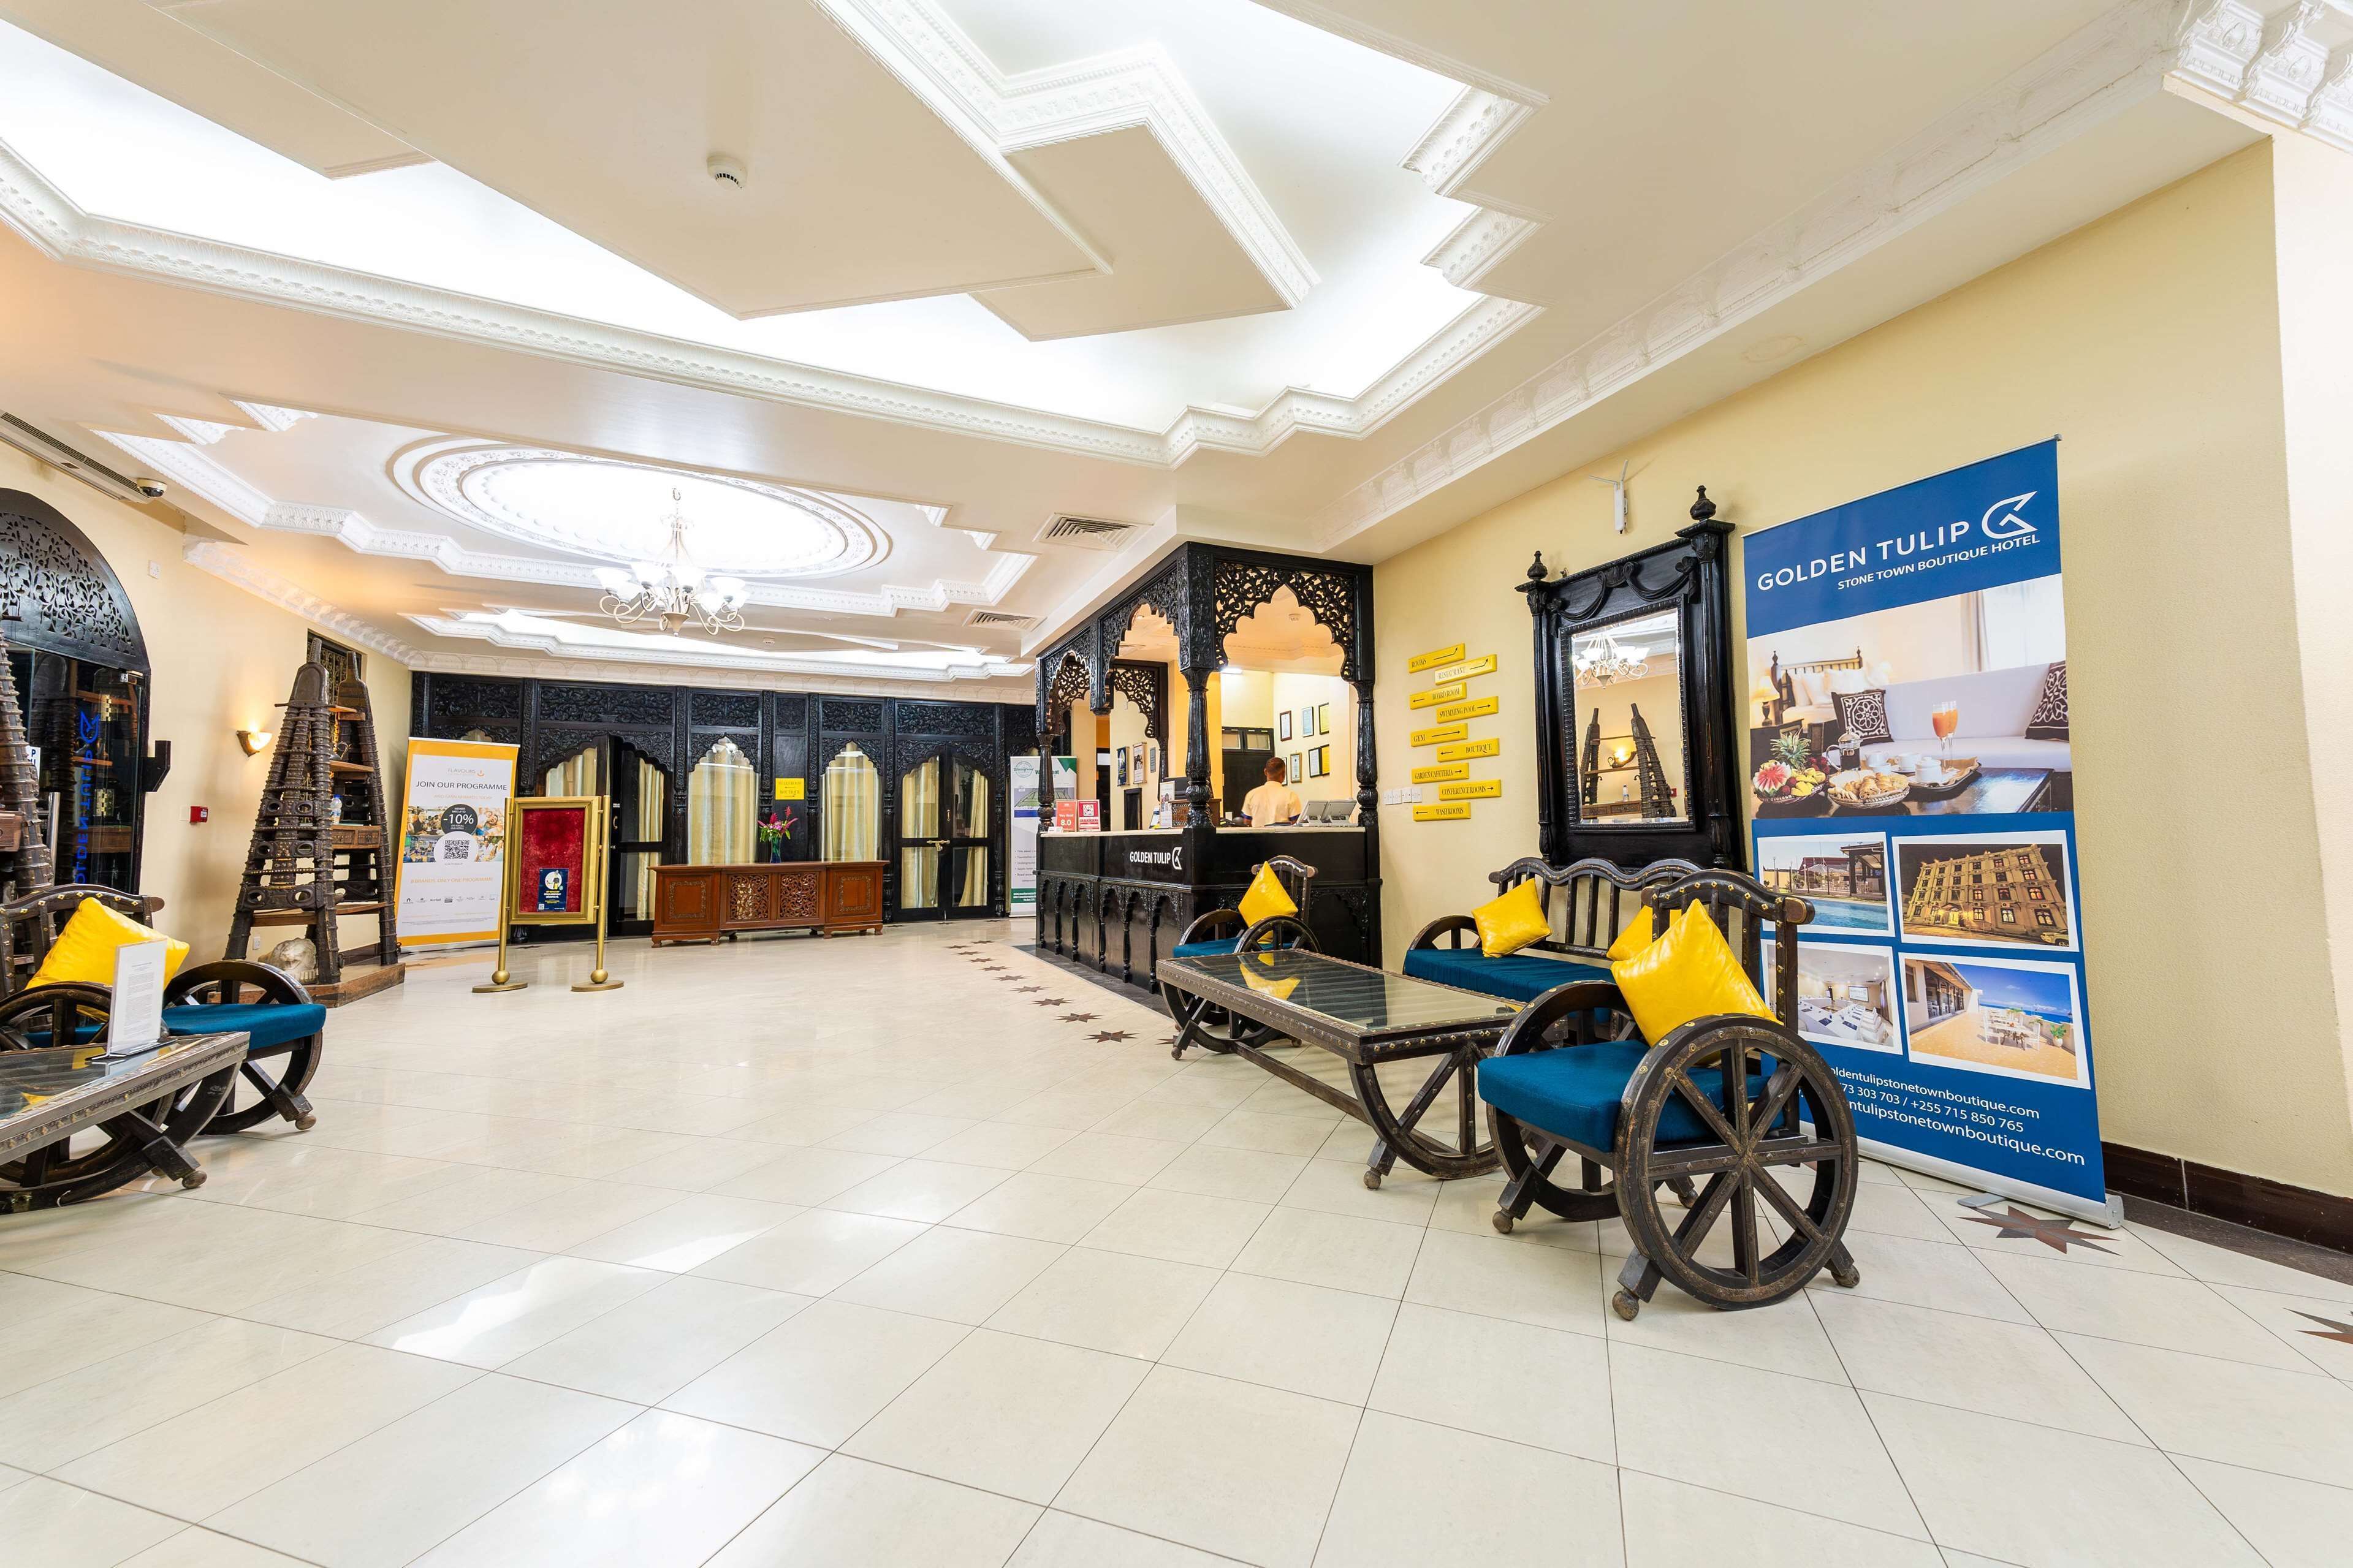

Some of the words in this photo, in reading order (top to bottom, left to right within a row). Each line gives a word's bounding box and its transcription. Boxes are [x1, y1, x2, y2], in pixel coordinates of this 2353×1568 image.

[1757, 547, 1866, 591] GOLDEN
[1876, 520, 1969, 561] TULIP
[1838, 572, 1874, 590] STONE
[1876, 563, 1915, 582] TOWN
[1917, 547, 1988, 570] BOUTIQUE
[1991, 535, 2040, 554] HOTEL
[1412, 658, 1427, 668] ROOMS
[1438, 666, 1465, 680] RESTAURANT
[1439, 706, 1463, 718] SWIMMING
[1464, 705, 1476, 714] POOL
[1465, 743, 1492, 753] BOUTIQUE
[1415, 771, 1431, 779] GARDEN
[1431, 769, 1453, 778] CAFETERIA
[443, 814, 474, 824] -10%
[1130, 851, 1152, 863] GOLDEN
[1154, 852, 1171, 864] TULIP
[1831, 1066, 2040, 1119] oldentulipstonetownboutique.com
[1839, 1082, 1855, 1094] 73
[1857, 1086, 1877, 1100] 303
[1879, 1091, 1900, 1105] 703
[1903, 1096, 1908, 1107] /
[1910, 1098, 1941, 1115] +255
[1944, 1104, 1968, 1120] 715
[1971, 1110, 1995, 1126] 850
[1998, 1117, 2024, 1134] 765
[1849, 1100, 2086, 1166] ntulipstonetownboutique.com
